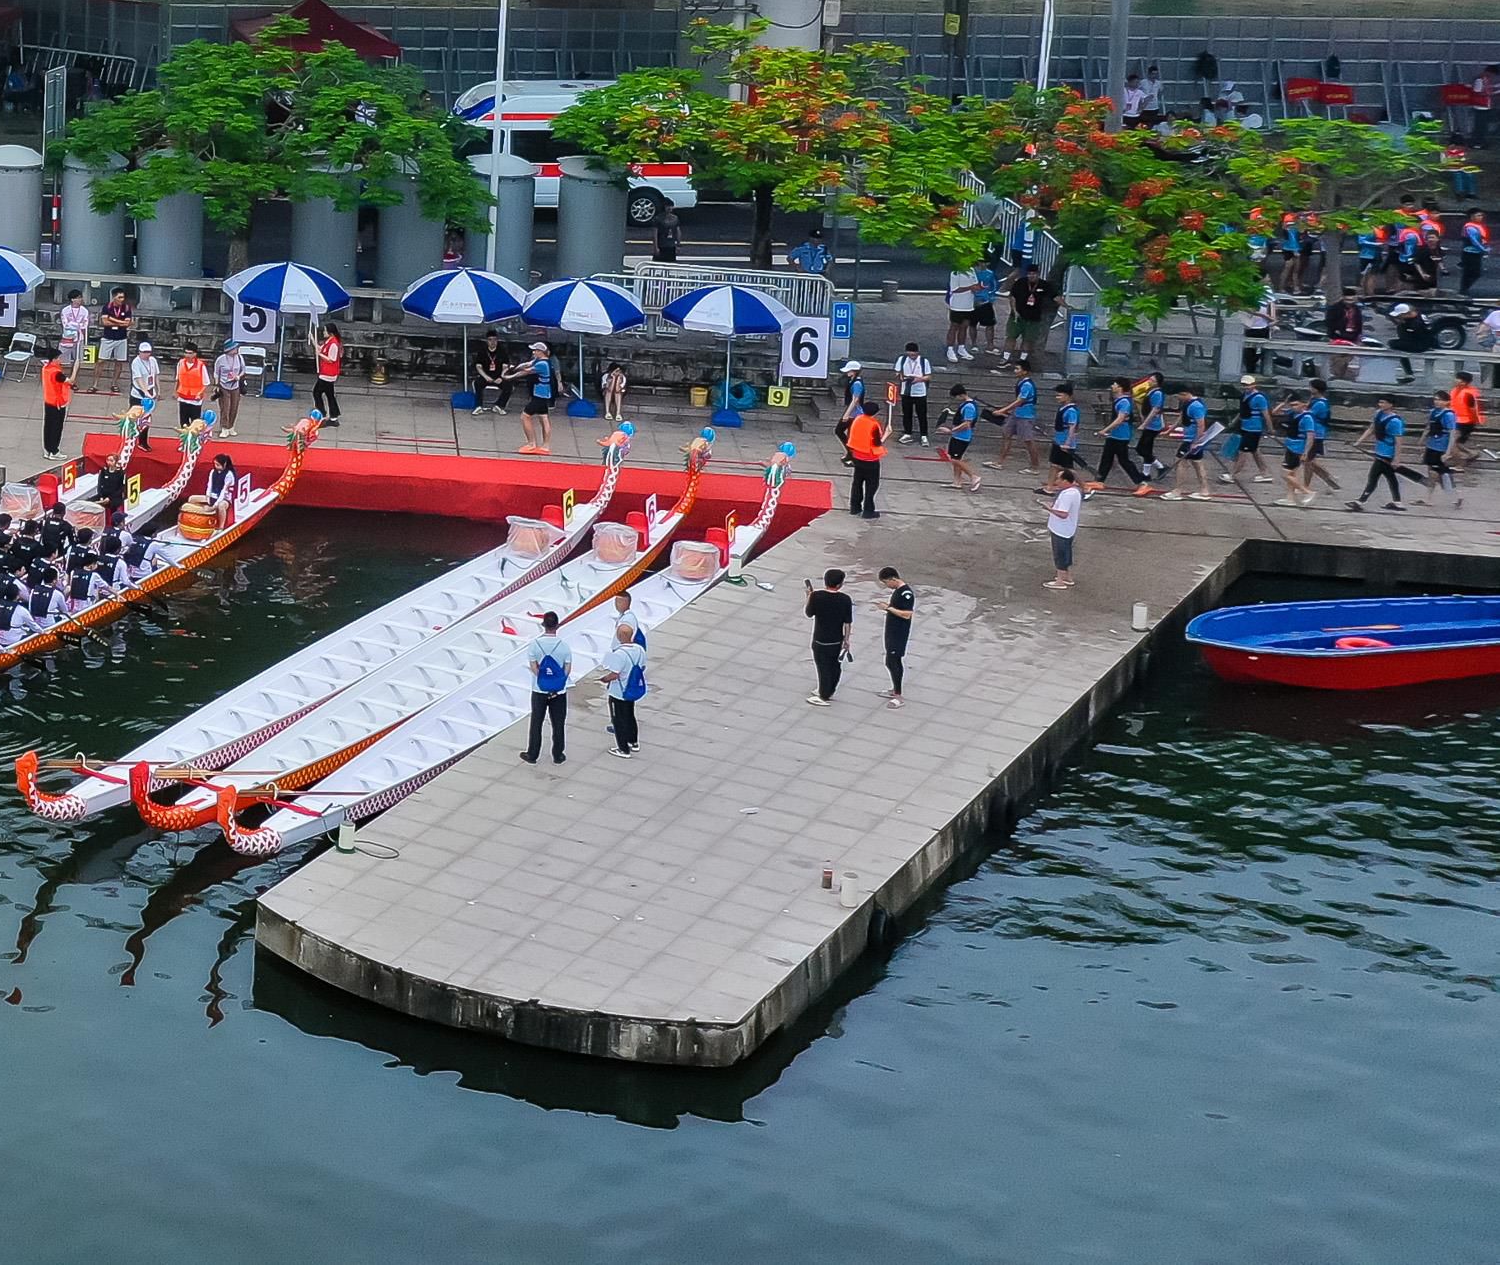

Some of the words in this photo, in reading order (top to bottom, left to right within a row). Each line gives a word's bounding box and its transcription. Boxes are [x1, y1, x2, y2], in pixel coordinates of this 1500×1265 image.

[241, 304, 267, 332] 5
[836, 308, 847, 333] 出口
[1073, 319, 1086, 346] 出口
[791, 326, 819, 368] 6
[64, 465, 74, 489] 5
[129, 480, 138, 504] 5
[239, 480, 248, 504] 5
[565, 495, 573, 520] 6
[648, 500, 656, 527] 6
[727, 517, 735, 541] 6
